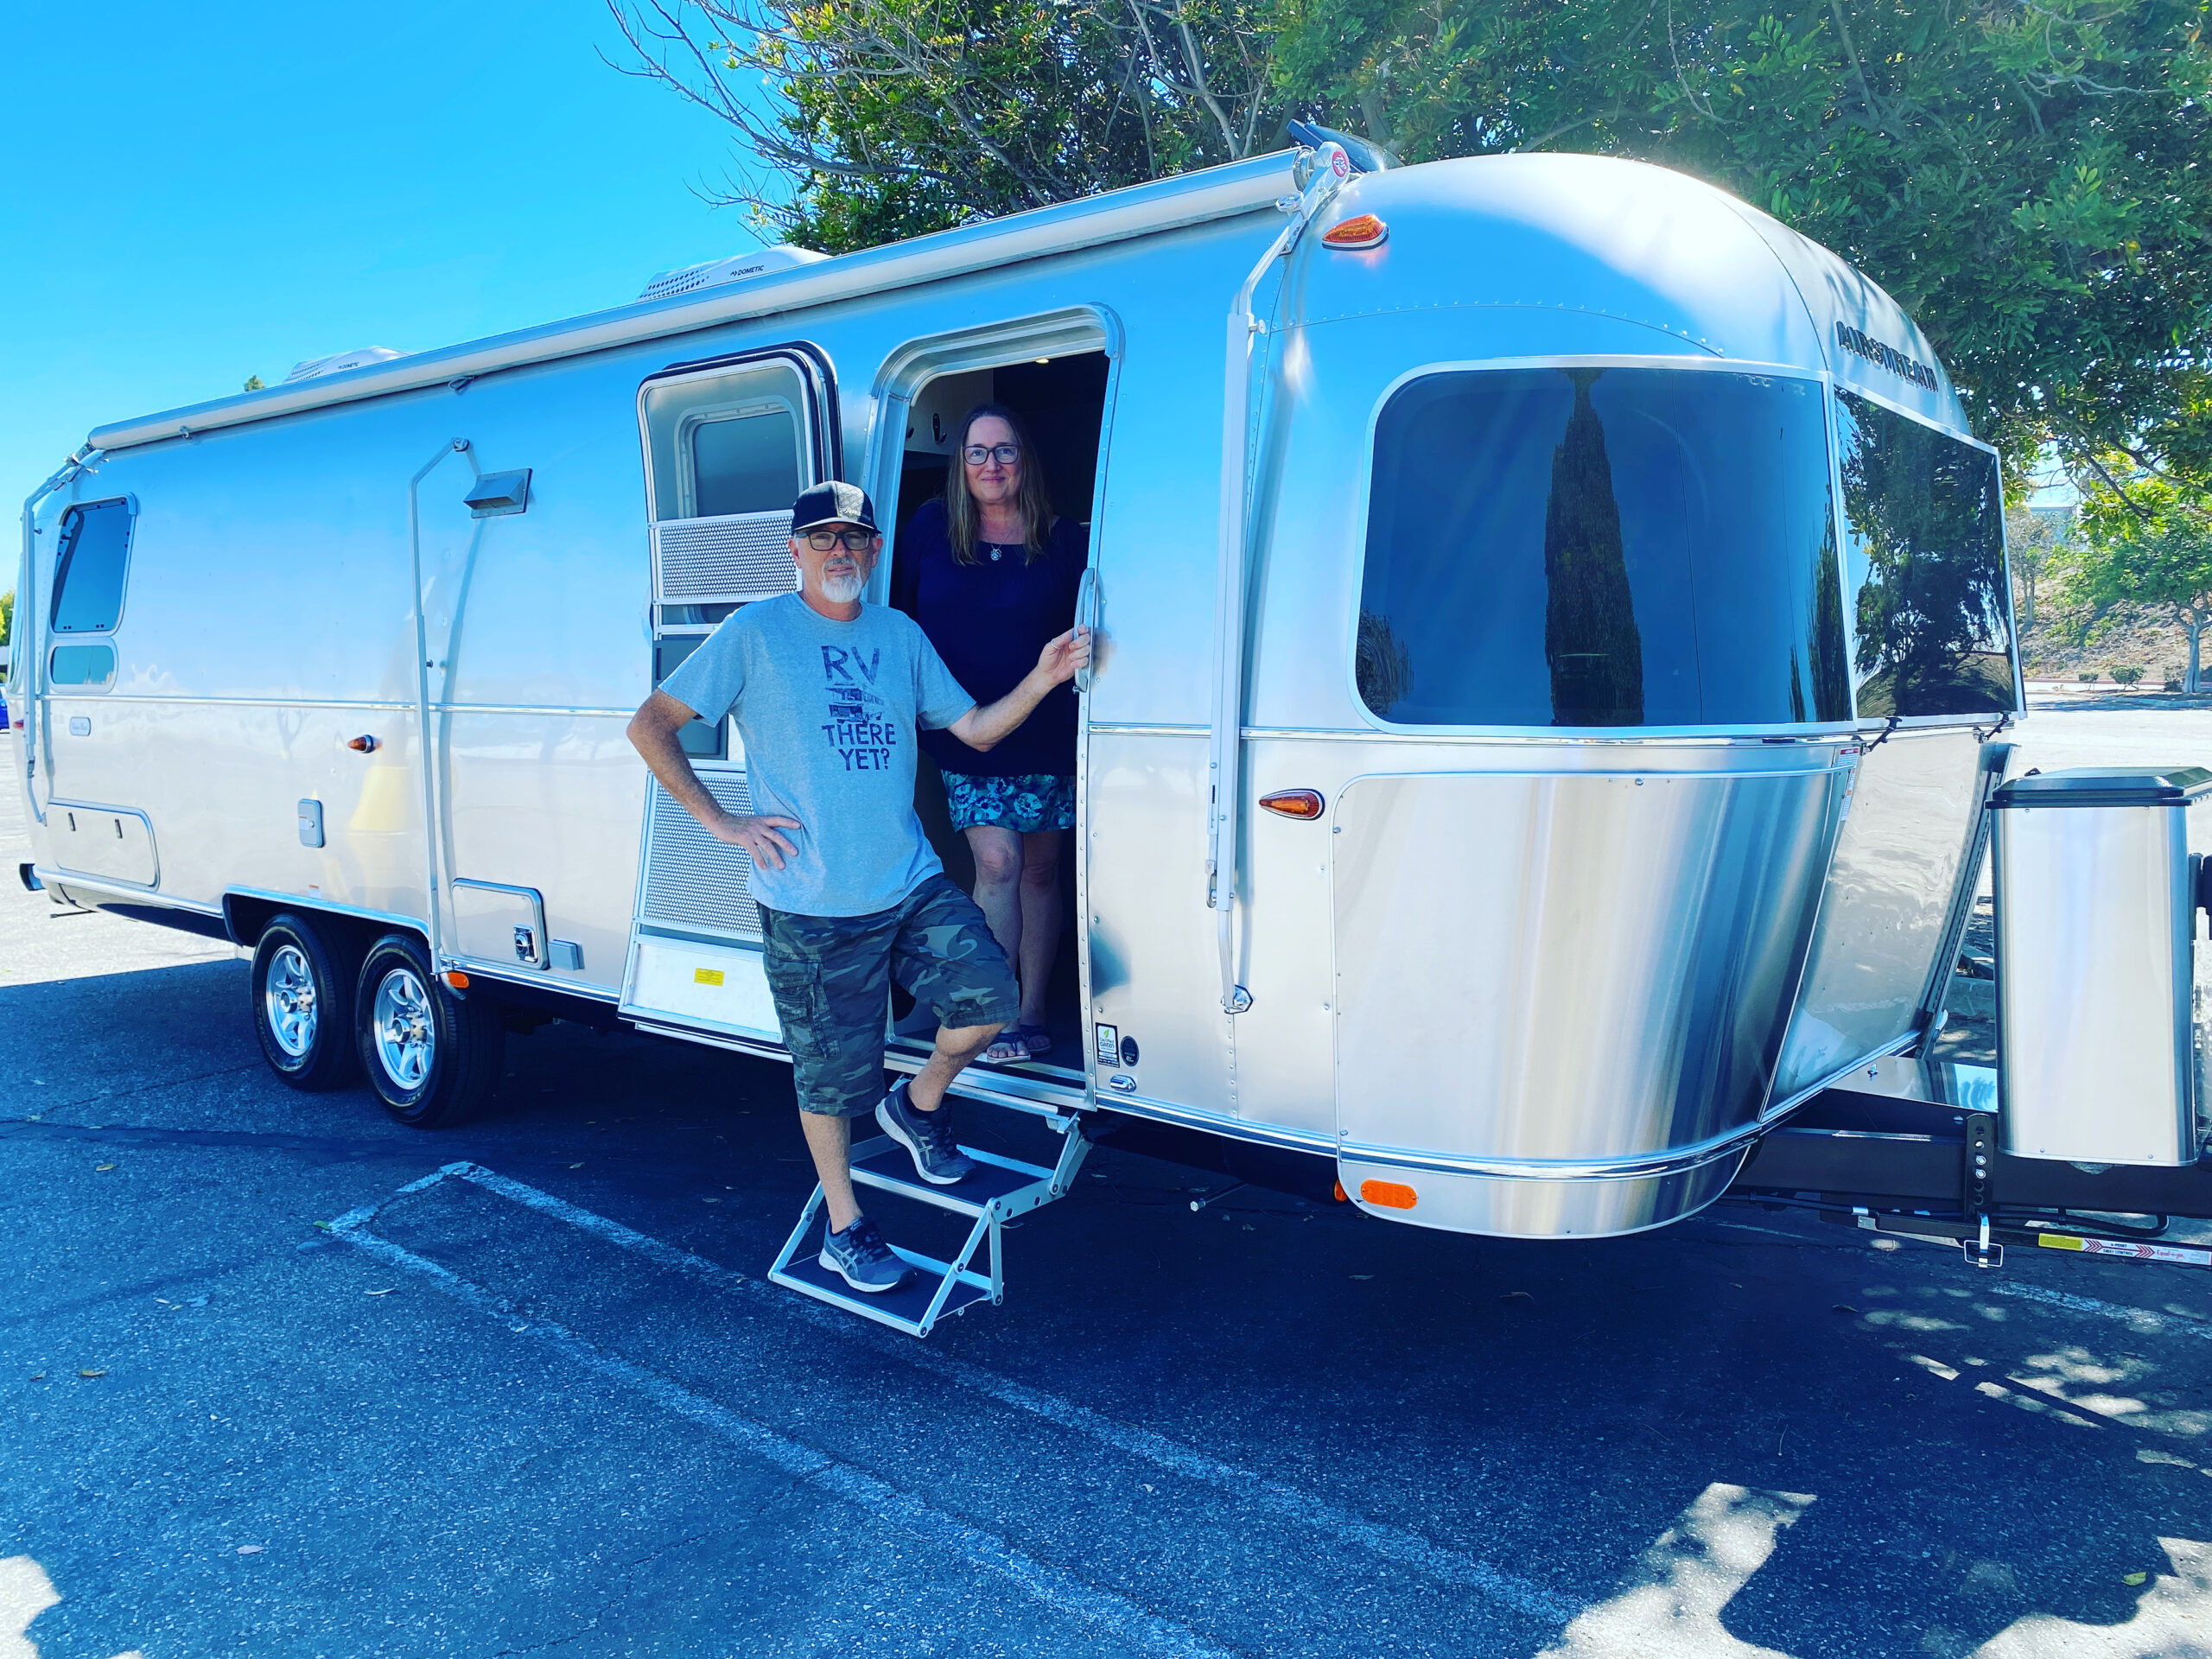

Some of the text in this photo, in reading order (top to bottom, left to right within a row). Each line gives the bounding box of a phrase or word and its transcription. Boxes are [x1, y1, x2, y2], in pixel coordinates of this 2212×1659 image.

[737, 265, 765, 276] DOMETIC
[1835, 320, 1939, 393] AIRSTREAM
[821, 645, 880, 685] RV
[822, 722, 897, 747] THERE
[837, 748, 891, 771] YET?
